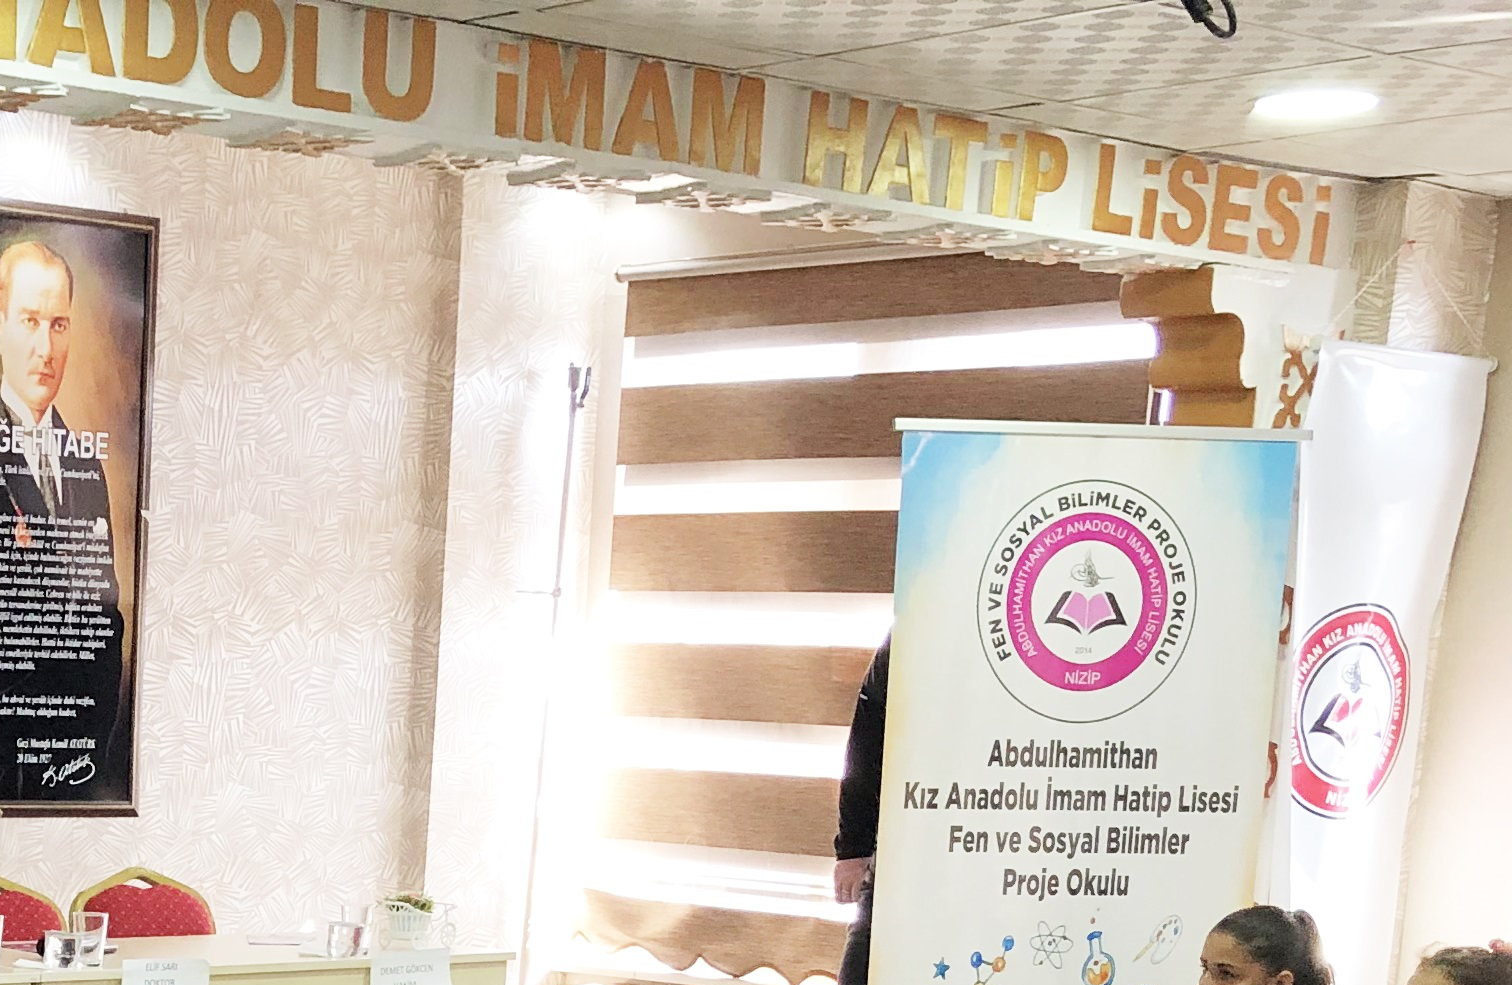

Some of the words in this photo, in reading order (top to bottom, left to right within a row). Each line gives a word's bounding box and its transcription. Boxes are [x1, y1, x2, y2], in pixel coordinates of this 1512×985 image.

[32, 420, 109, 460] HİTABE
[995, 506, 1054, 577] SOSYAL
[1043, 527, 1066, 548] KIZ
[1066, 519, 1128, 540] ANADOLU
[1147, 518, 1186, 585] PROJE
[989, 581, 1004, 612] VE
[989, 618, 1012, 662] FEN
[1154, 590, 1187, 666] OKULU
[1322, 627, 1345, 649] KIZ
[1064, 669, 1102, 685] NİZİP
[987, 739, 1158, 769] Abdulhamithan
[903, 781, 939, 809] Kız
[945, 781, 1039, 811] Anadolu
[1045, 776, 1106, 812] İmam
[1113, 783, 1171, 818] Hatip
[1178, 785, 1240, 814] Lisesi
[948, 825, 989, 853] Fen
[995, 832, 1022, 853] ve
[1028, 825, 1100, 859] Sosyal
[1106, 826, 1190, 855] Bilimler
[1002, 868, 1059, 901] Proje
[1066, 868, 1130, 897] Okulu
